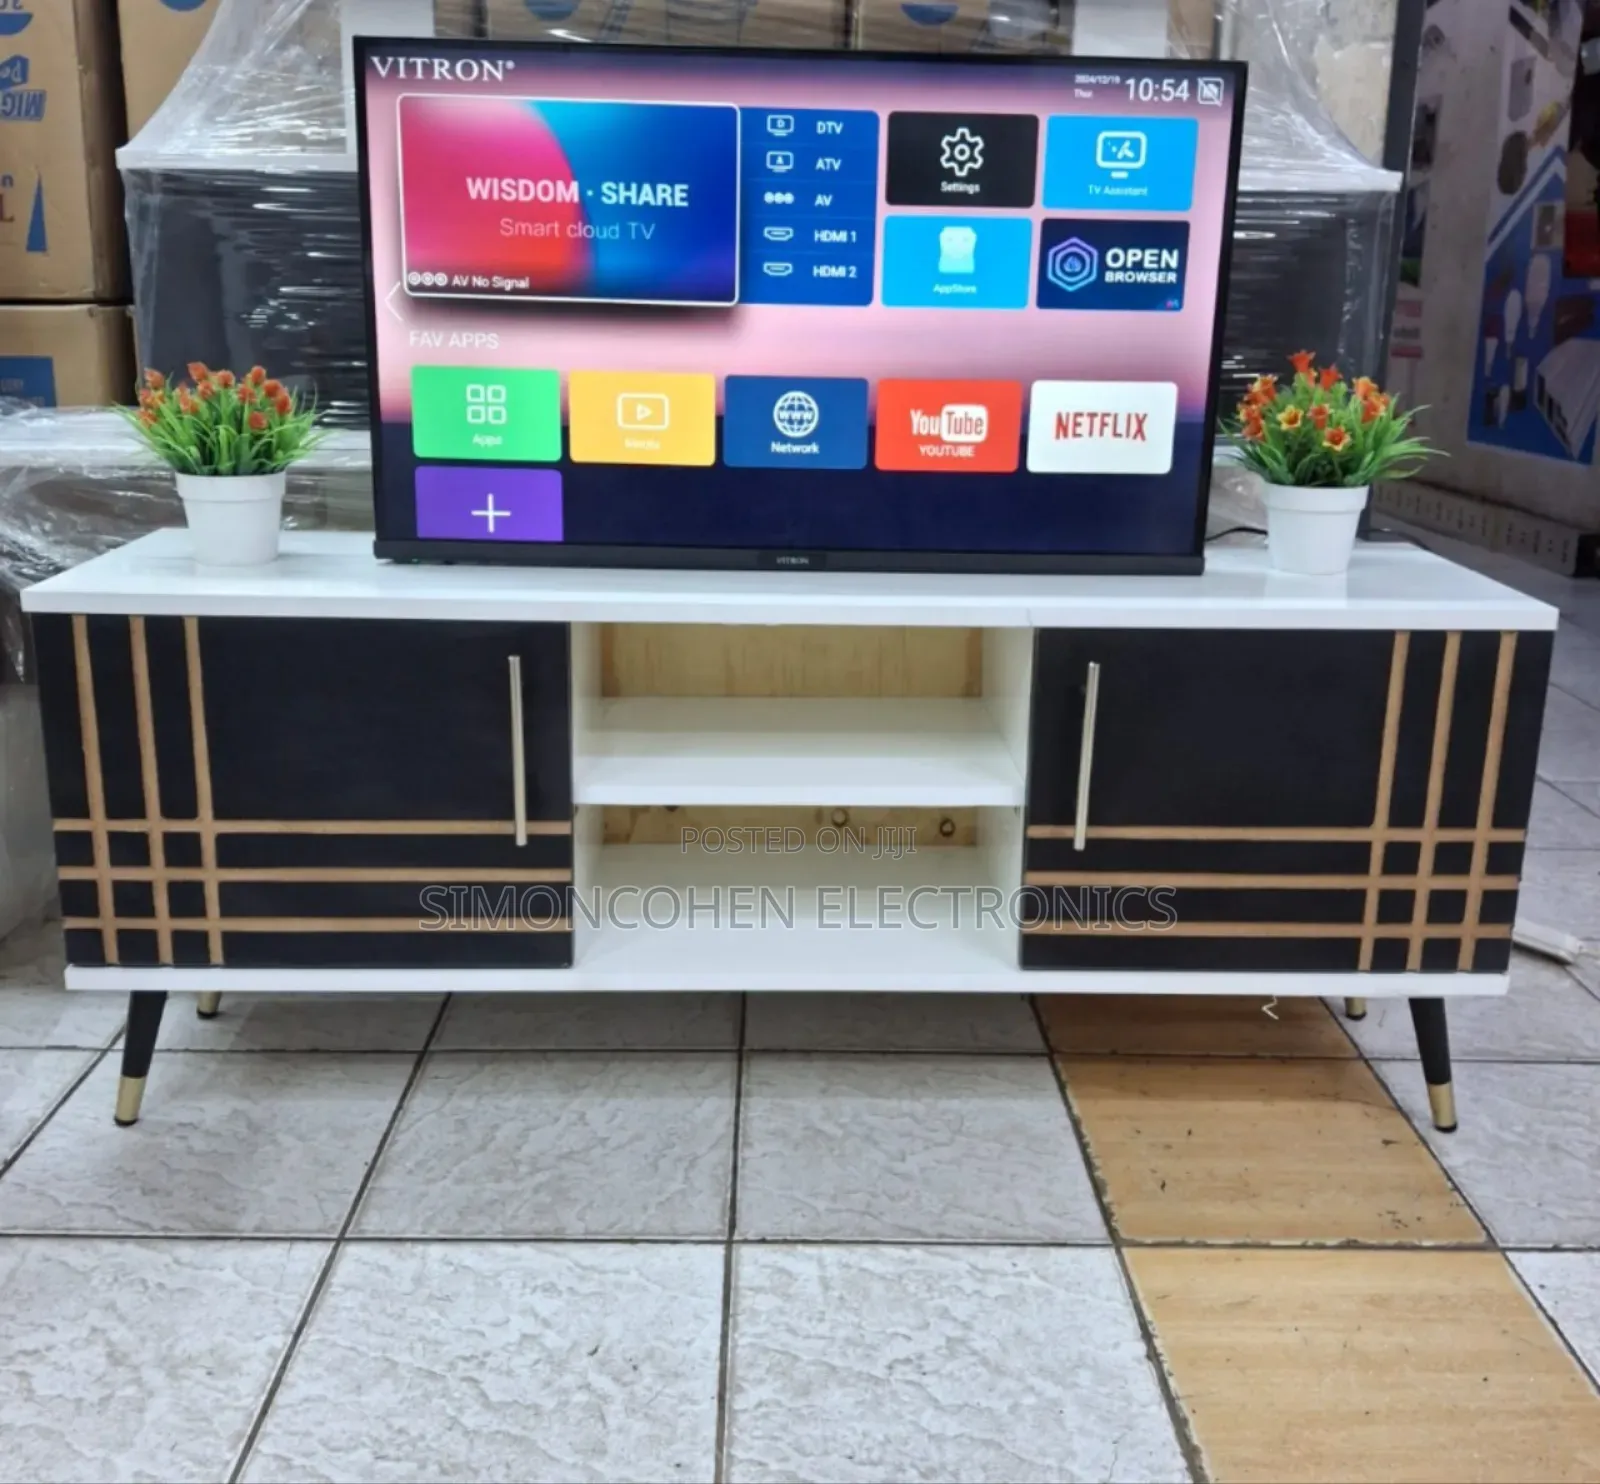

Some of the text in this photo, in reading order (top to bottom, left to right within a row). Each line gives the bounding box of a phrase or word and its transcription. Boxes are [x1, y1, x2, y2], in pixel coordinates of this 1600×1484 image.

[370, 56, 504, 82] VITRON
[1125, 77, 1190, 103] 10:54
[816, 121, 843, 135] DTV
[815, 158, 842, 171] ATV
[466, 177, 689, 207] WISDOM SHARE
[941, 181, 980, 194] Settings
[1088, 184, 1101, 195] TV
[814, 194, 833, 207] AV
[500, 217, 656, 240] Smart cloud TV
[814, 230, 857, 243] HDMI 1
[1105, 248, 1179, 268] OPEN
[813, 265, 857, 279] HDMI 2
[1104, 271, 1177, 284] BROWSER
[452, 275, 530, 291] AV No Signal
[409, 331, 499, 349] FAV APPS
[1055, 412, 1148, 441] NETFLIX
[472, 433, 503, 447] Apps
[771, 441, 820, 454] Network
[919, 445, 975, 457] YOUTUBE
